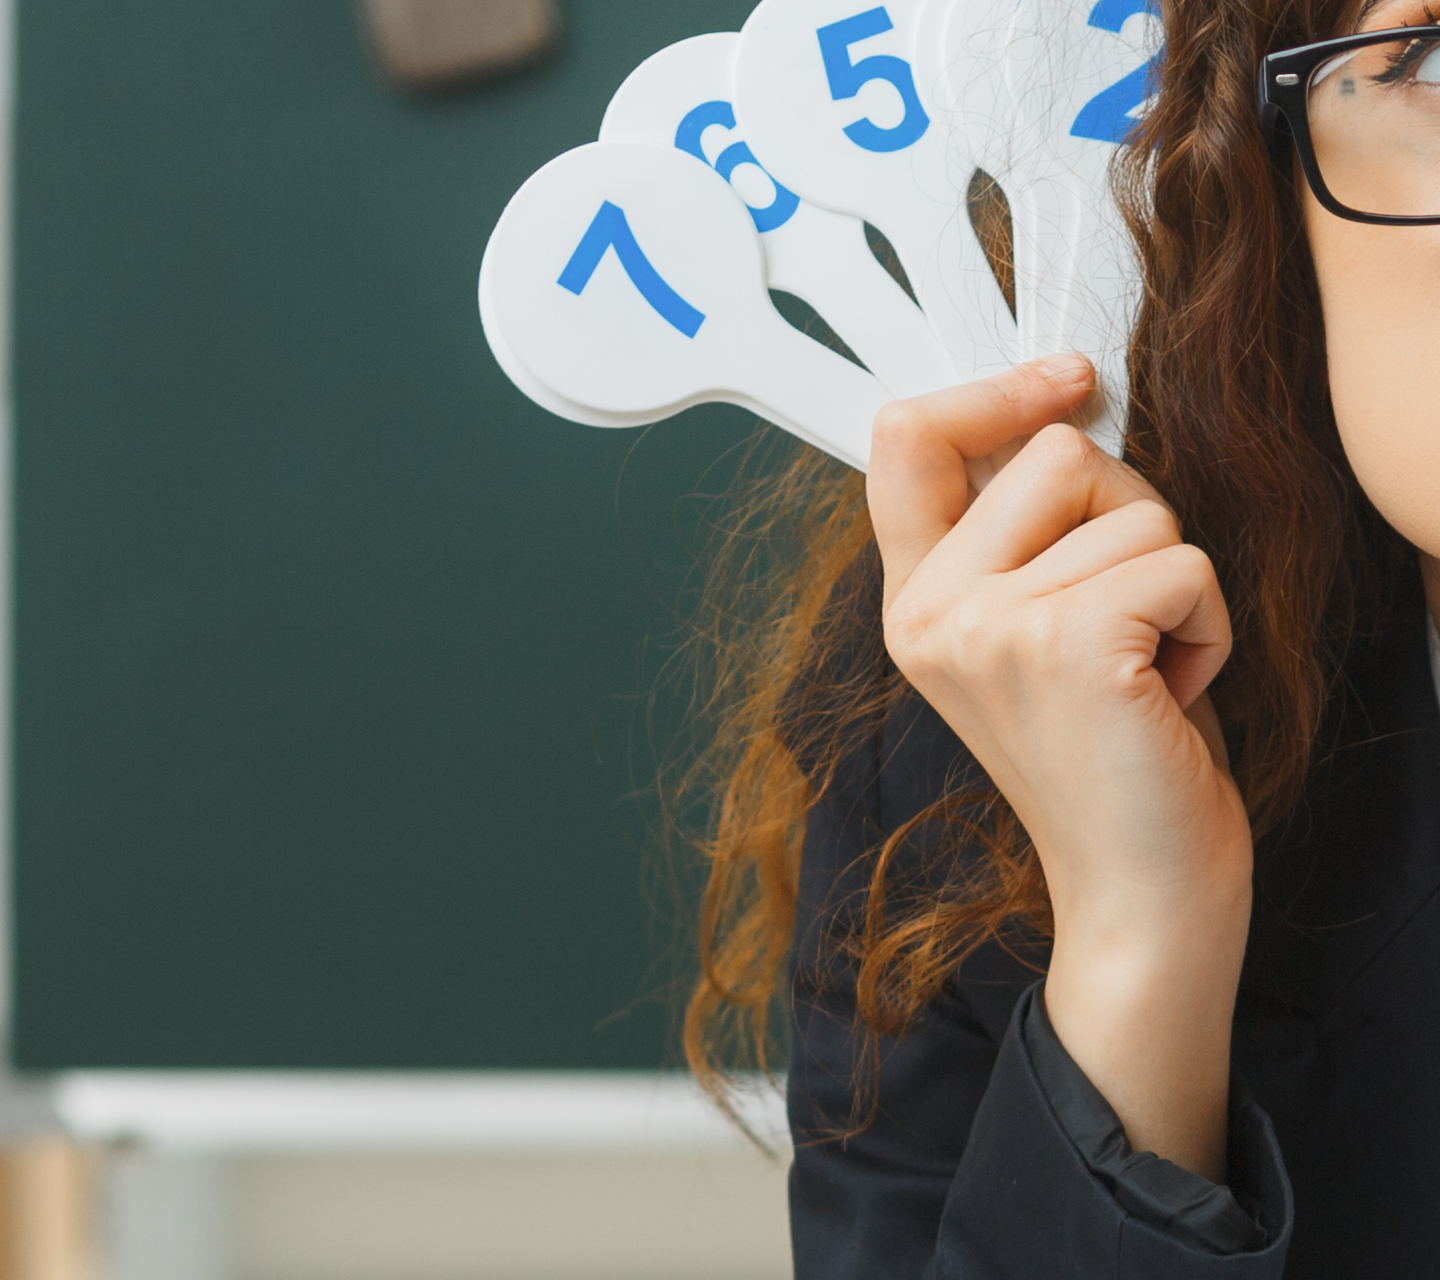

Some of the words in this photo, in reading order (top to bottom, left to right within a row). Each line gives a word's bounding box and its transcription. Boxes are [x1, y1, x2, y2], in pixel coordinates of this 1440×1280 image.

[815, 5, 931, 154] 5
[673, 99, 801, 234] 6
[556, 199, 707, 340] 7
